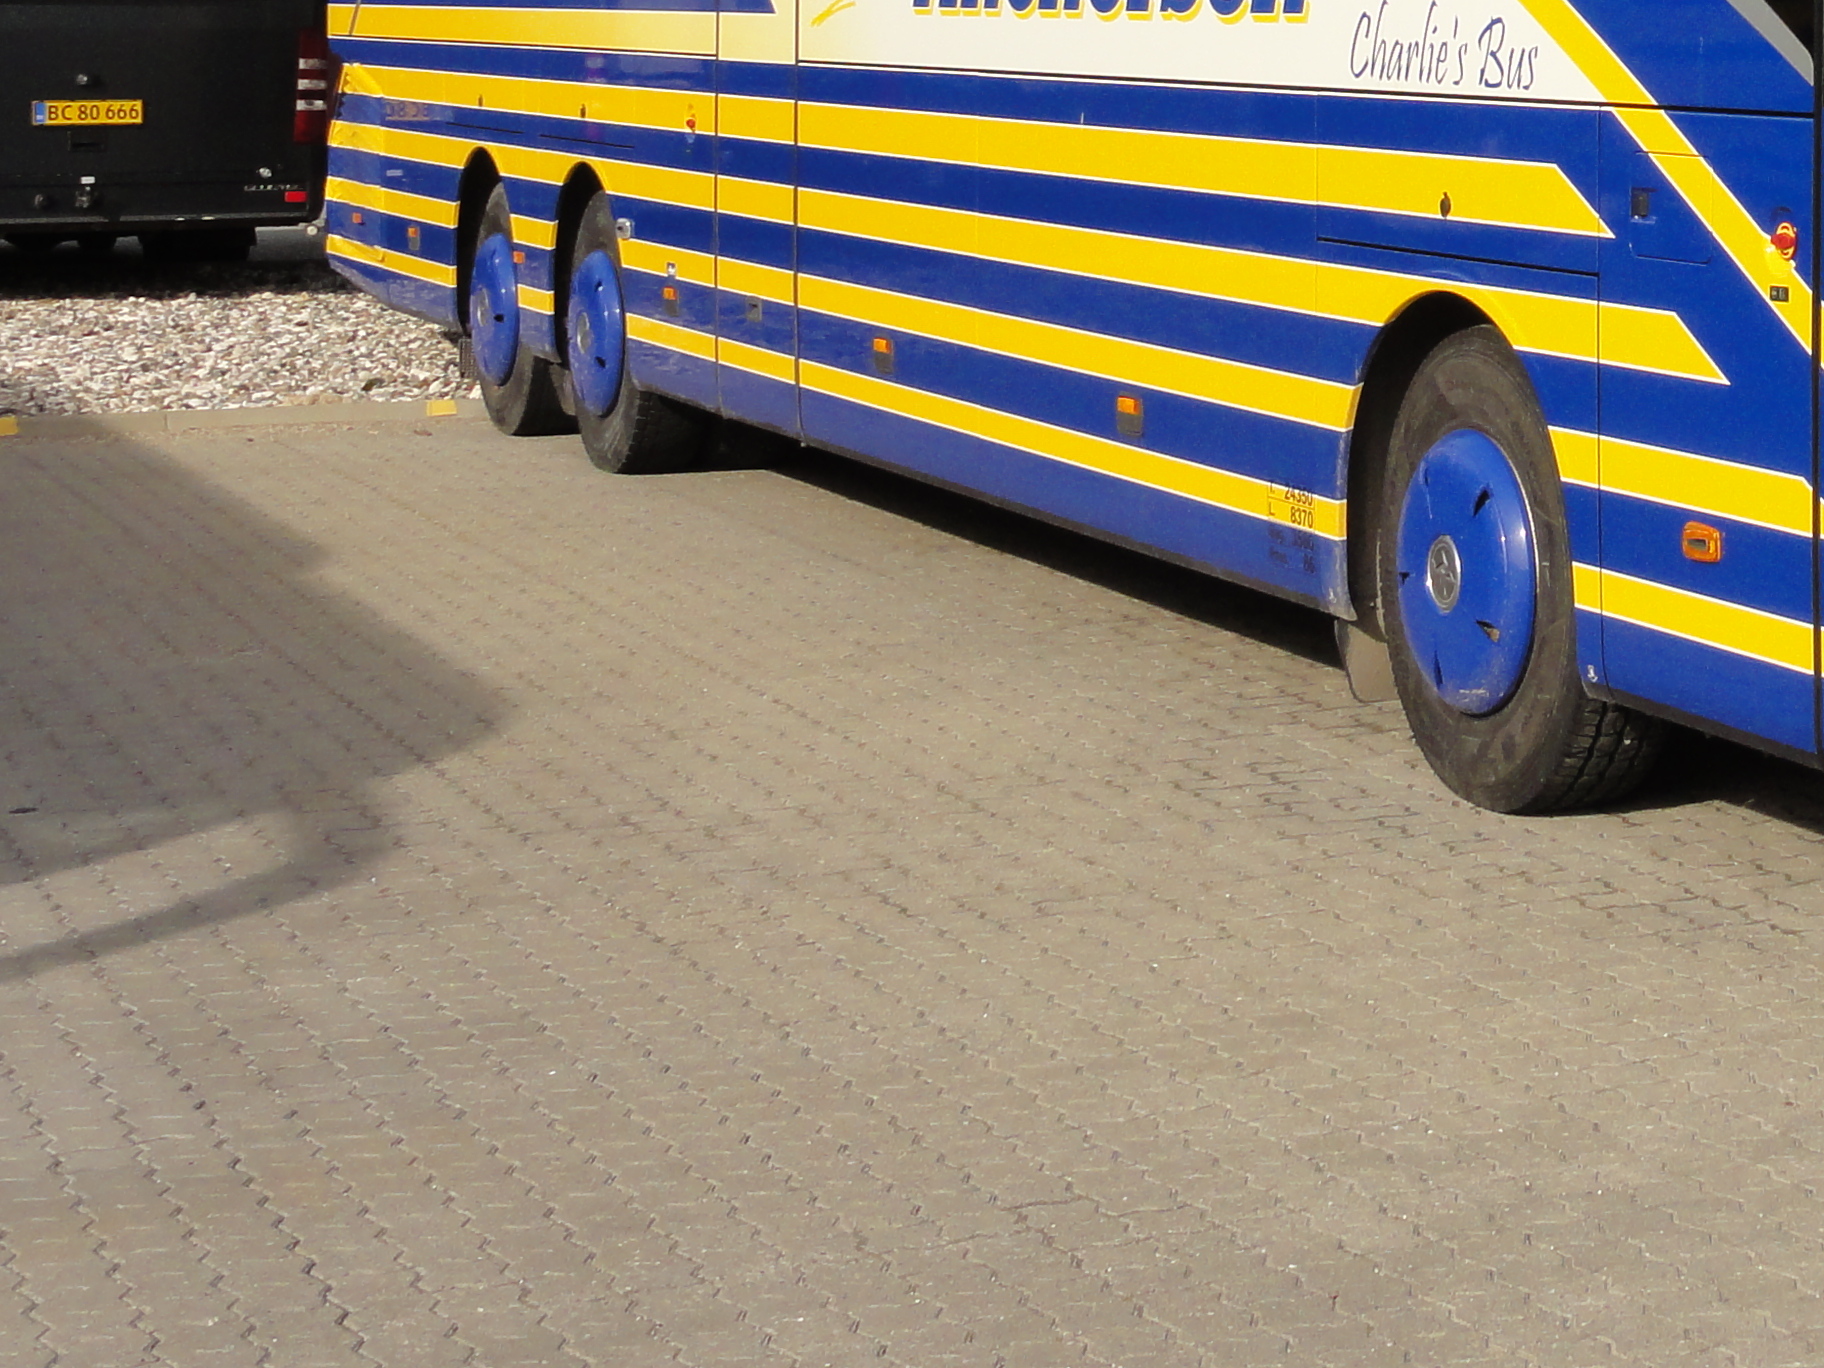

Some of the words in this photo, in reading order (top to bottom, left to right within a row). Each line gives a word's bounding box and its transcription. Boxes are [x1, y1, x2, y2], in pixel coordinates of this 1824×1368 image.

[1478, 16, 1539, 91] Bus
[48, 105, 72, 121] BC
[77, 104, 100, 120] 80
[105, 103, 139, 119] 666
